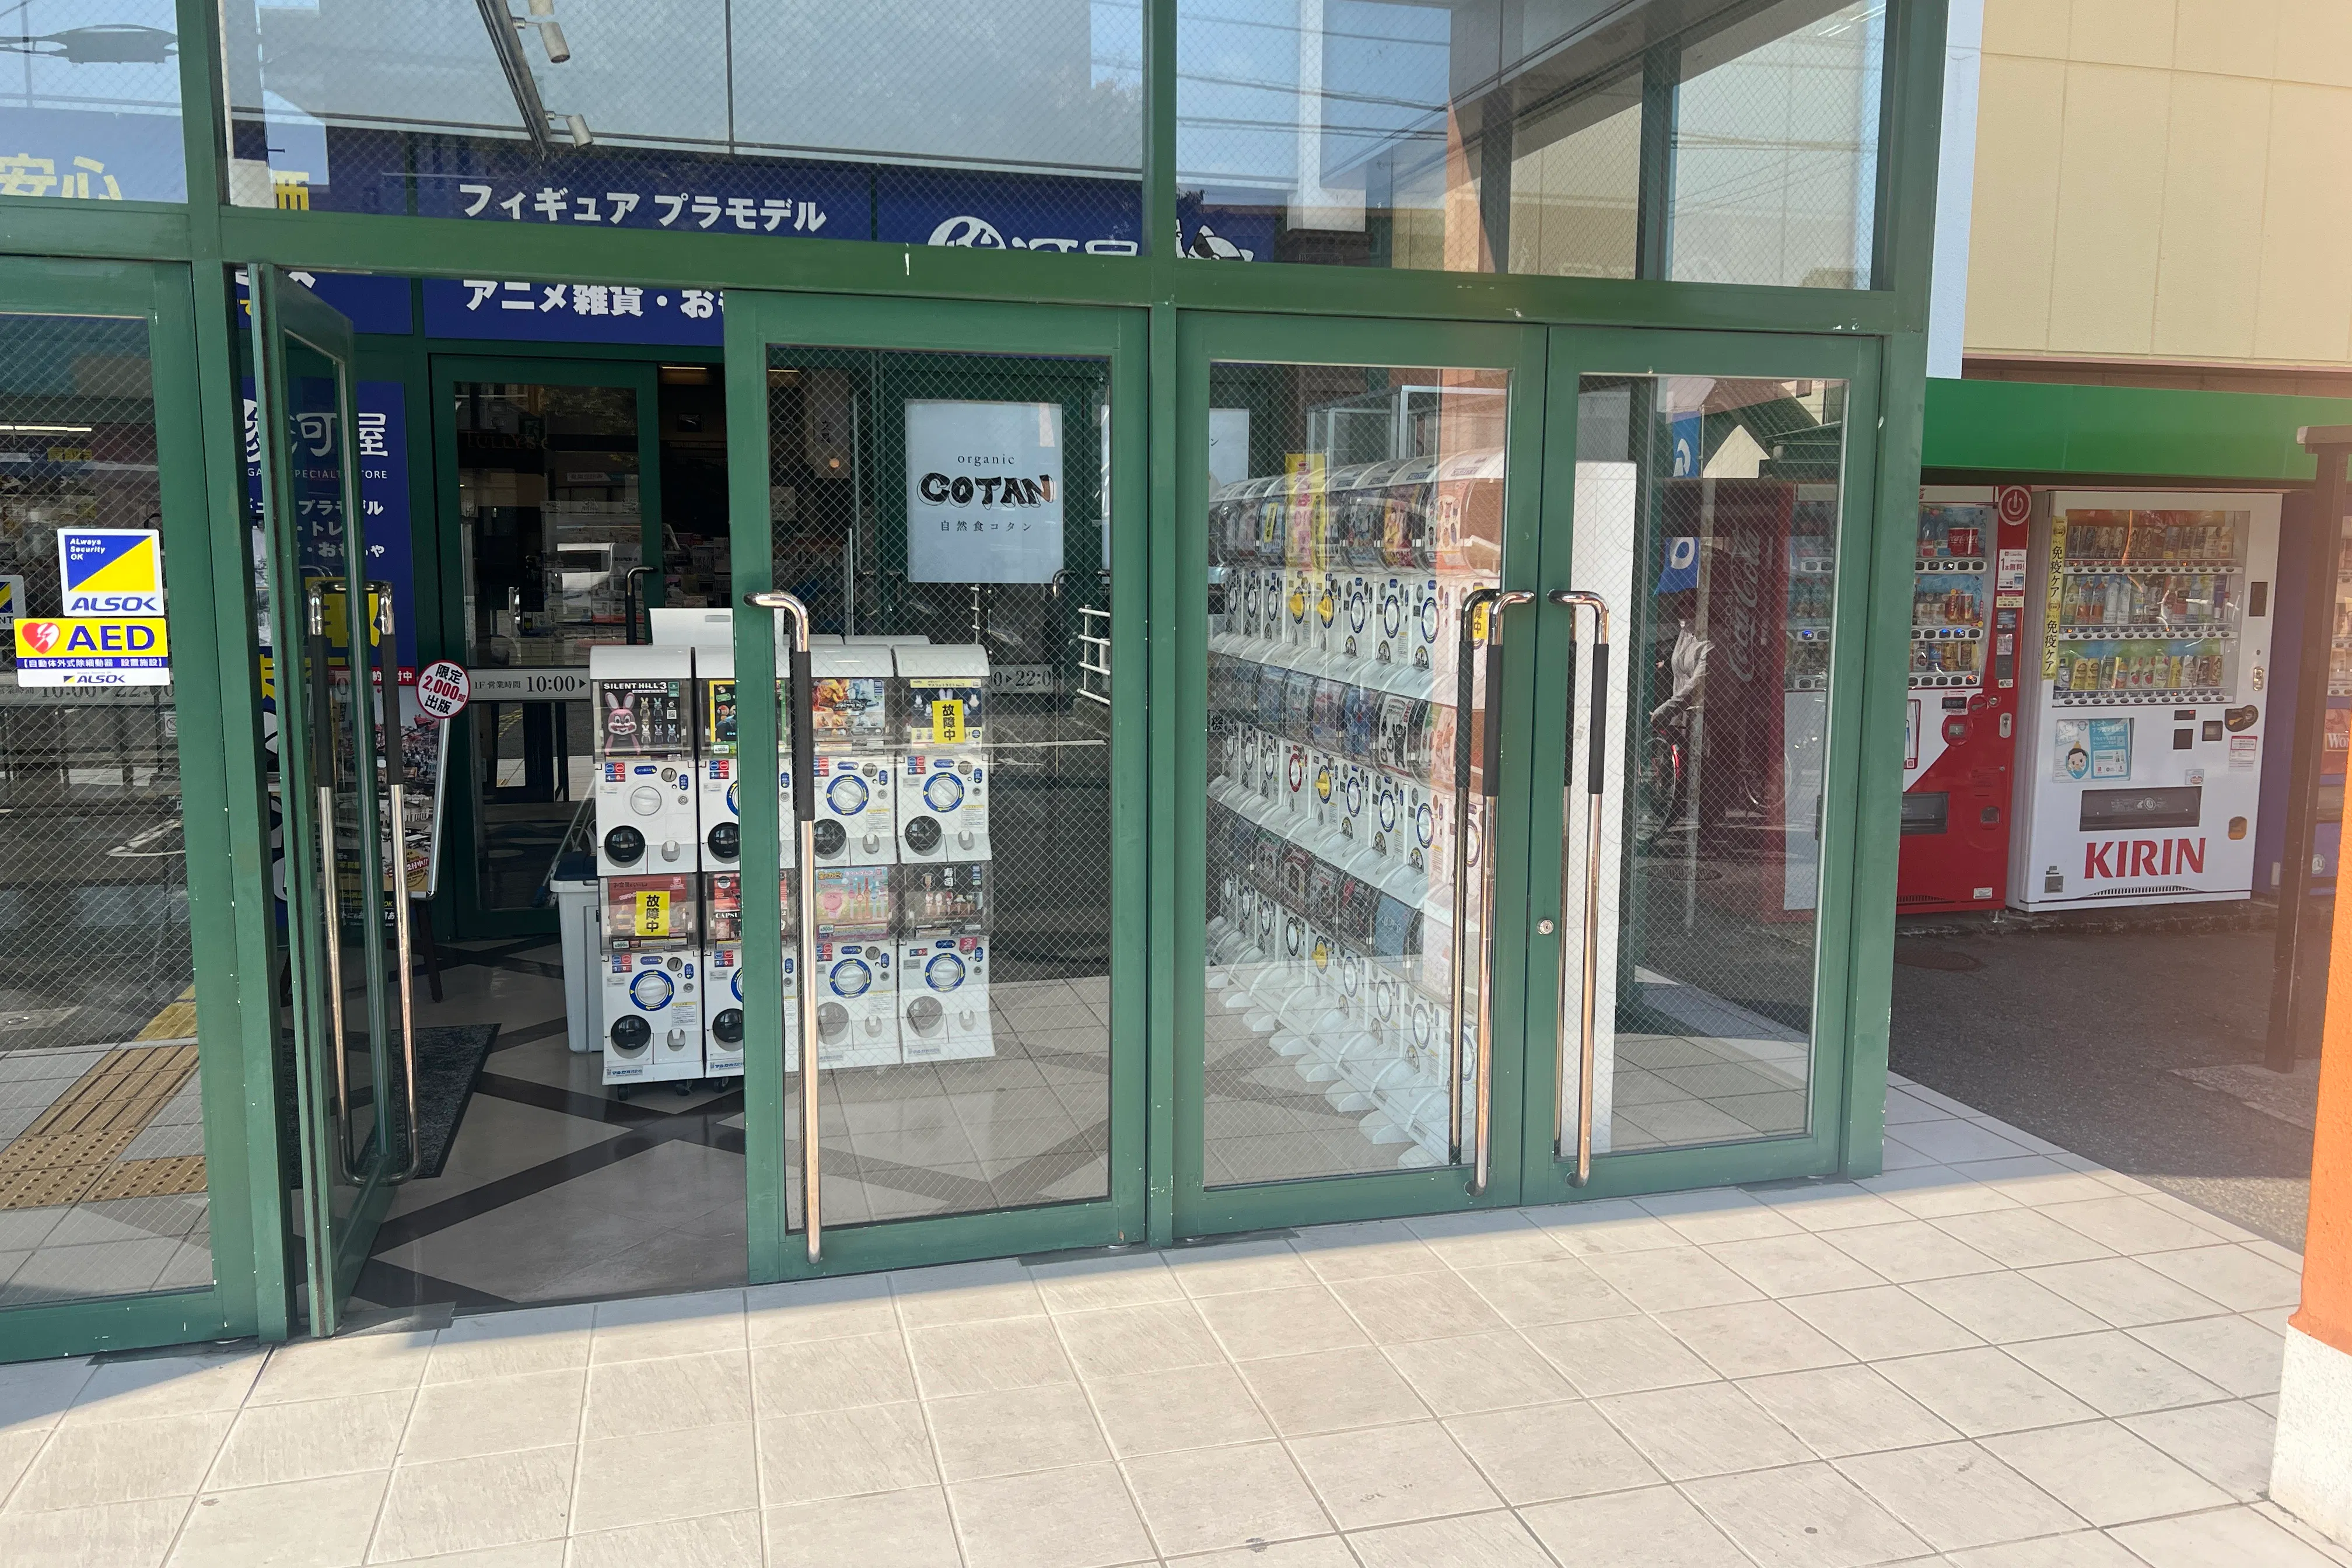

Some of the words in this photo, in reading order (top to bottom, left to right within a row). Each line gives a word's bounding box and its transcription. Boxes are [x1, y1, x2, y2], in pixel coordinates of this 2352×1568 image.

[459, 184, 640, 224] フィギュア
[654, 192, 827, 232] プラモデル
[463, 279, 723, 319] アニメ雑貨・お
[958, 453, 1015, 468] organic
[916, 471, 1056, 510] COTAN
[940, 520, 1031, 532] 自然食コタン
[70, 546, 106, 554] Security
[2050, 546, 2063, 598] 免疫ケア
[70, 596, 158, 612] ALSOK
[66, 625, 155, 651] AED
[2045, 620, 2058, 671] 免疫ケア
[77, 674, 125, 684] ALSOK
[435, 664, 463, 685] 限定
[474, 681, 485, 690] 1F
[487, 681, 521, 690] 営業時間
[526, 675, 575, 693] 10:00
[659, 681, 667, 690] 3
[422, 675, 466, 703] 2,000部
[424, 694, 453, 715] 出版
[942, 704, 956, 741] 故障中
[2084, 837, 2206, 879] KIRIN
[646, 894, 660, 933] 故障中
